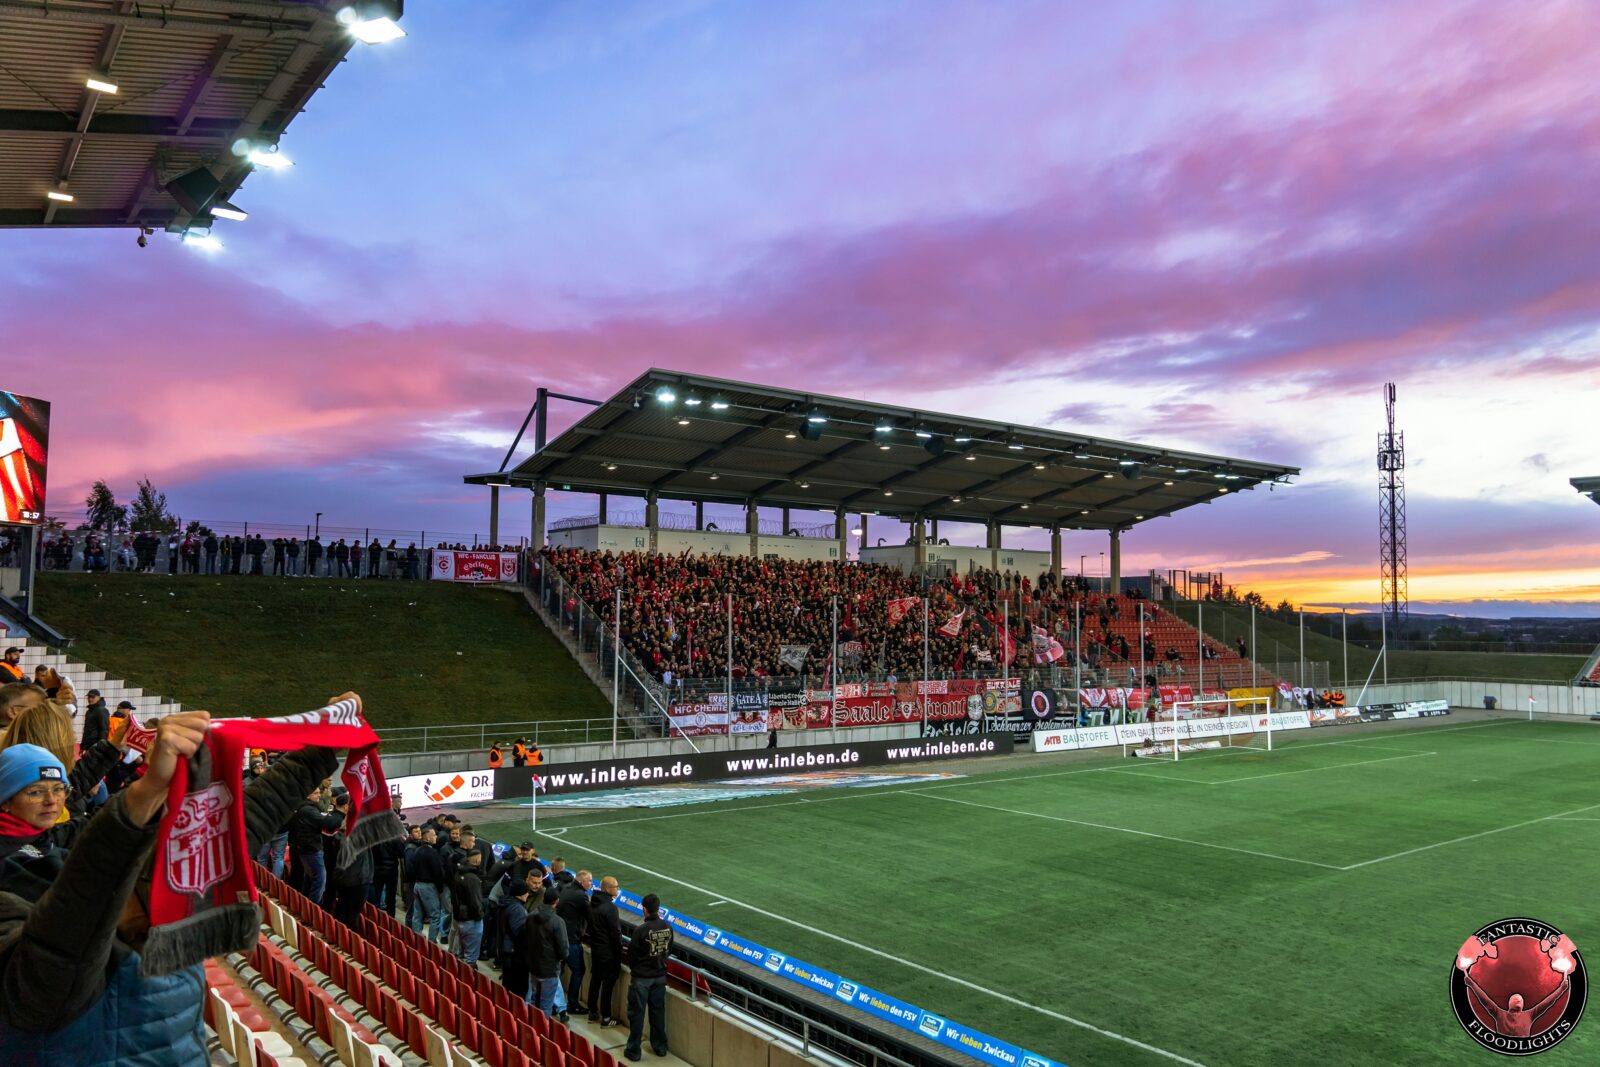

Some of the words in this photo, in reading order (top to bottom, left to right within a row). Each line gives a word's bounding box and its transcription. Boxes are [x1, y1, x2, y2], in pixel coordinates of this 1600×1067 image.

[674, 705, 692, 714] HFC
[830, 700, 889, 723] Saale
[886, 738, 996, 760] www.inleben.de
[1043, 735, 1062, 746] MTB
[1063, 731, 1110, 744] BAUSTOFFE
[726, 748, 861, 773] www.inleben.de
[471, 775, 494, 788] DR.
[685, 921, 704, 936] Zwickau
[720, 937, 730, 947] Wir
[728, 941, 744, 953] lieben
[742, 946, 753, 957] den
[751, 950, 764, 961] FSV
[784, 962, 796, 974] Wir
[793, 967, 811, 980] lieben
[810, 972, 835, 990] Zwickau
[858, 991, 871, 1004] Wir
[869, 996, 890, 1012] lieben
[889, 1005, 903, 1018] den
[902, 1009, 918, 1022] FSV
[946, 1027, 960, 1040] Wir
[959, 1033, 983, 1051] lieben
[982, 1042, 1016, 1064] Zwickau
